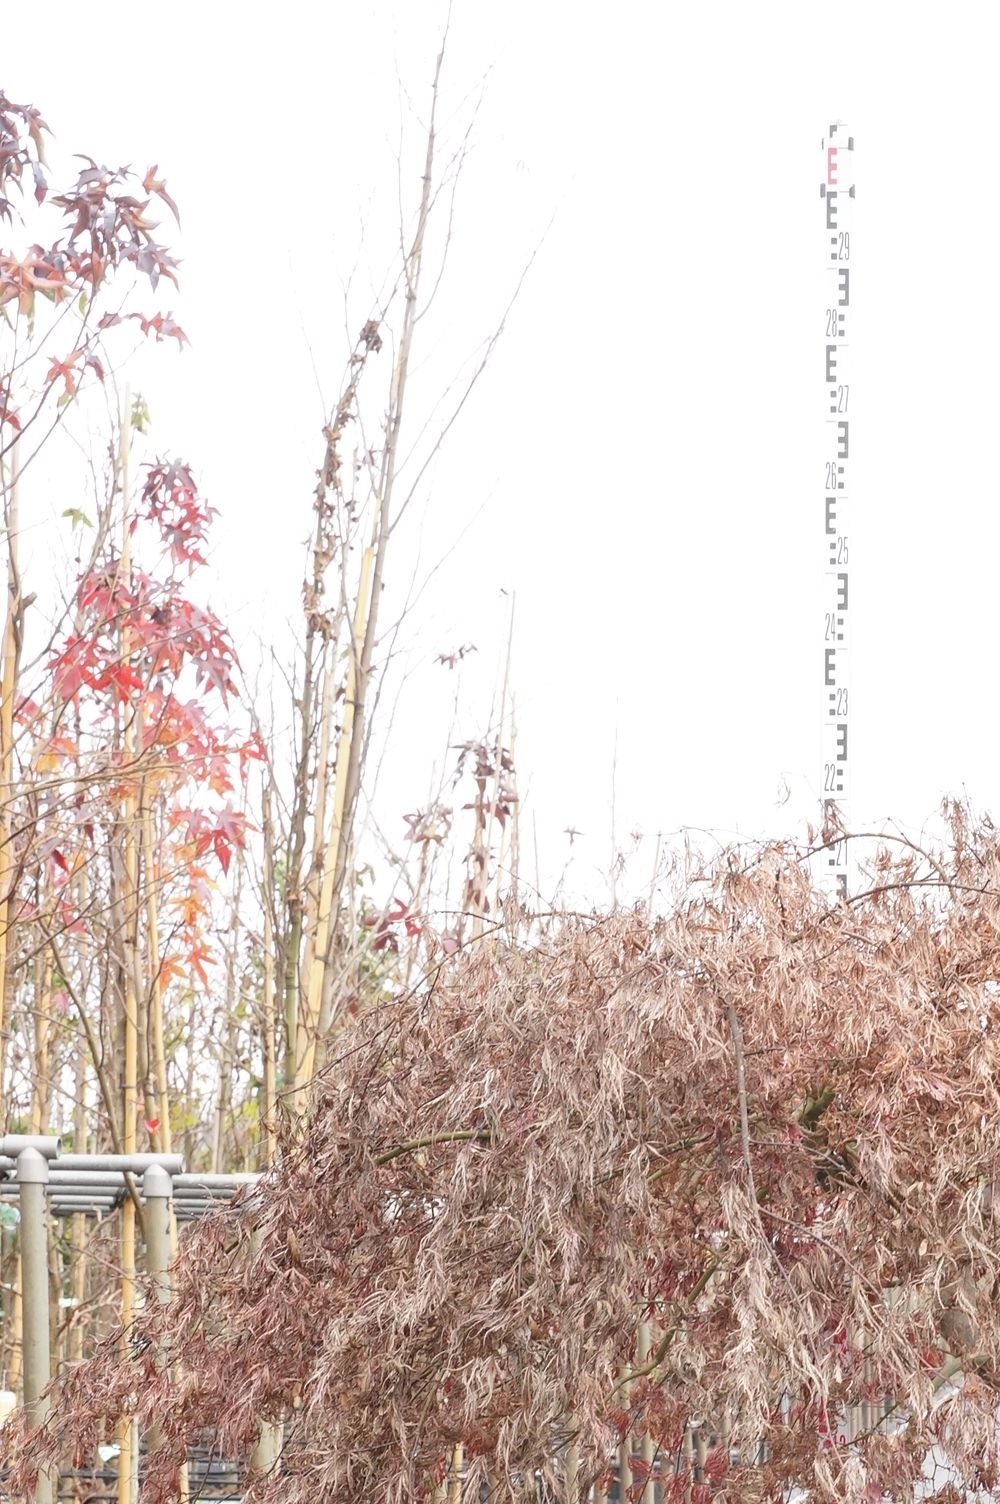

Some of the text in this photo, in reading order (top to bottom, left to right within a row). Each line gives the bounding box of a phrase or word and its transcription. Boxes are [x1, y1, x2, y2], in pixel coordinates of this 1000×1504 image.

[838, 231, 850, 261] 29
[825, 308, 838, 338] 28
[837, 384, 850, 414] 27
[825, 461, 837, 490] 26
[837, 536, 849, 565] 25
[824, 612, 836, 641] 24
[836, 687, 849, 717] 23
[824, 763, 836, 792] 22
[836, 839, 848, 866] 21
